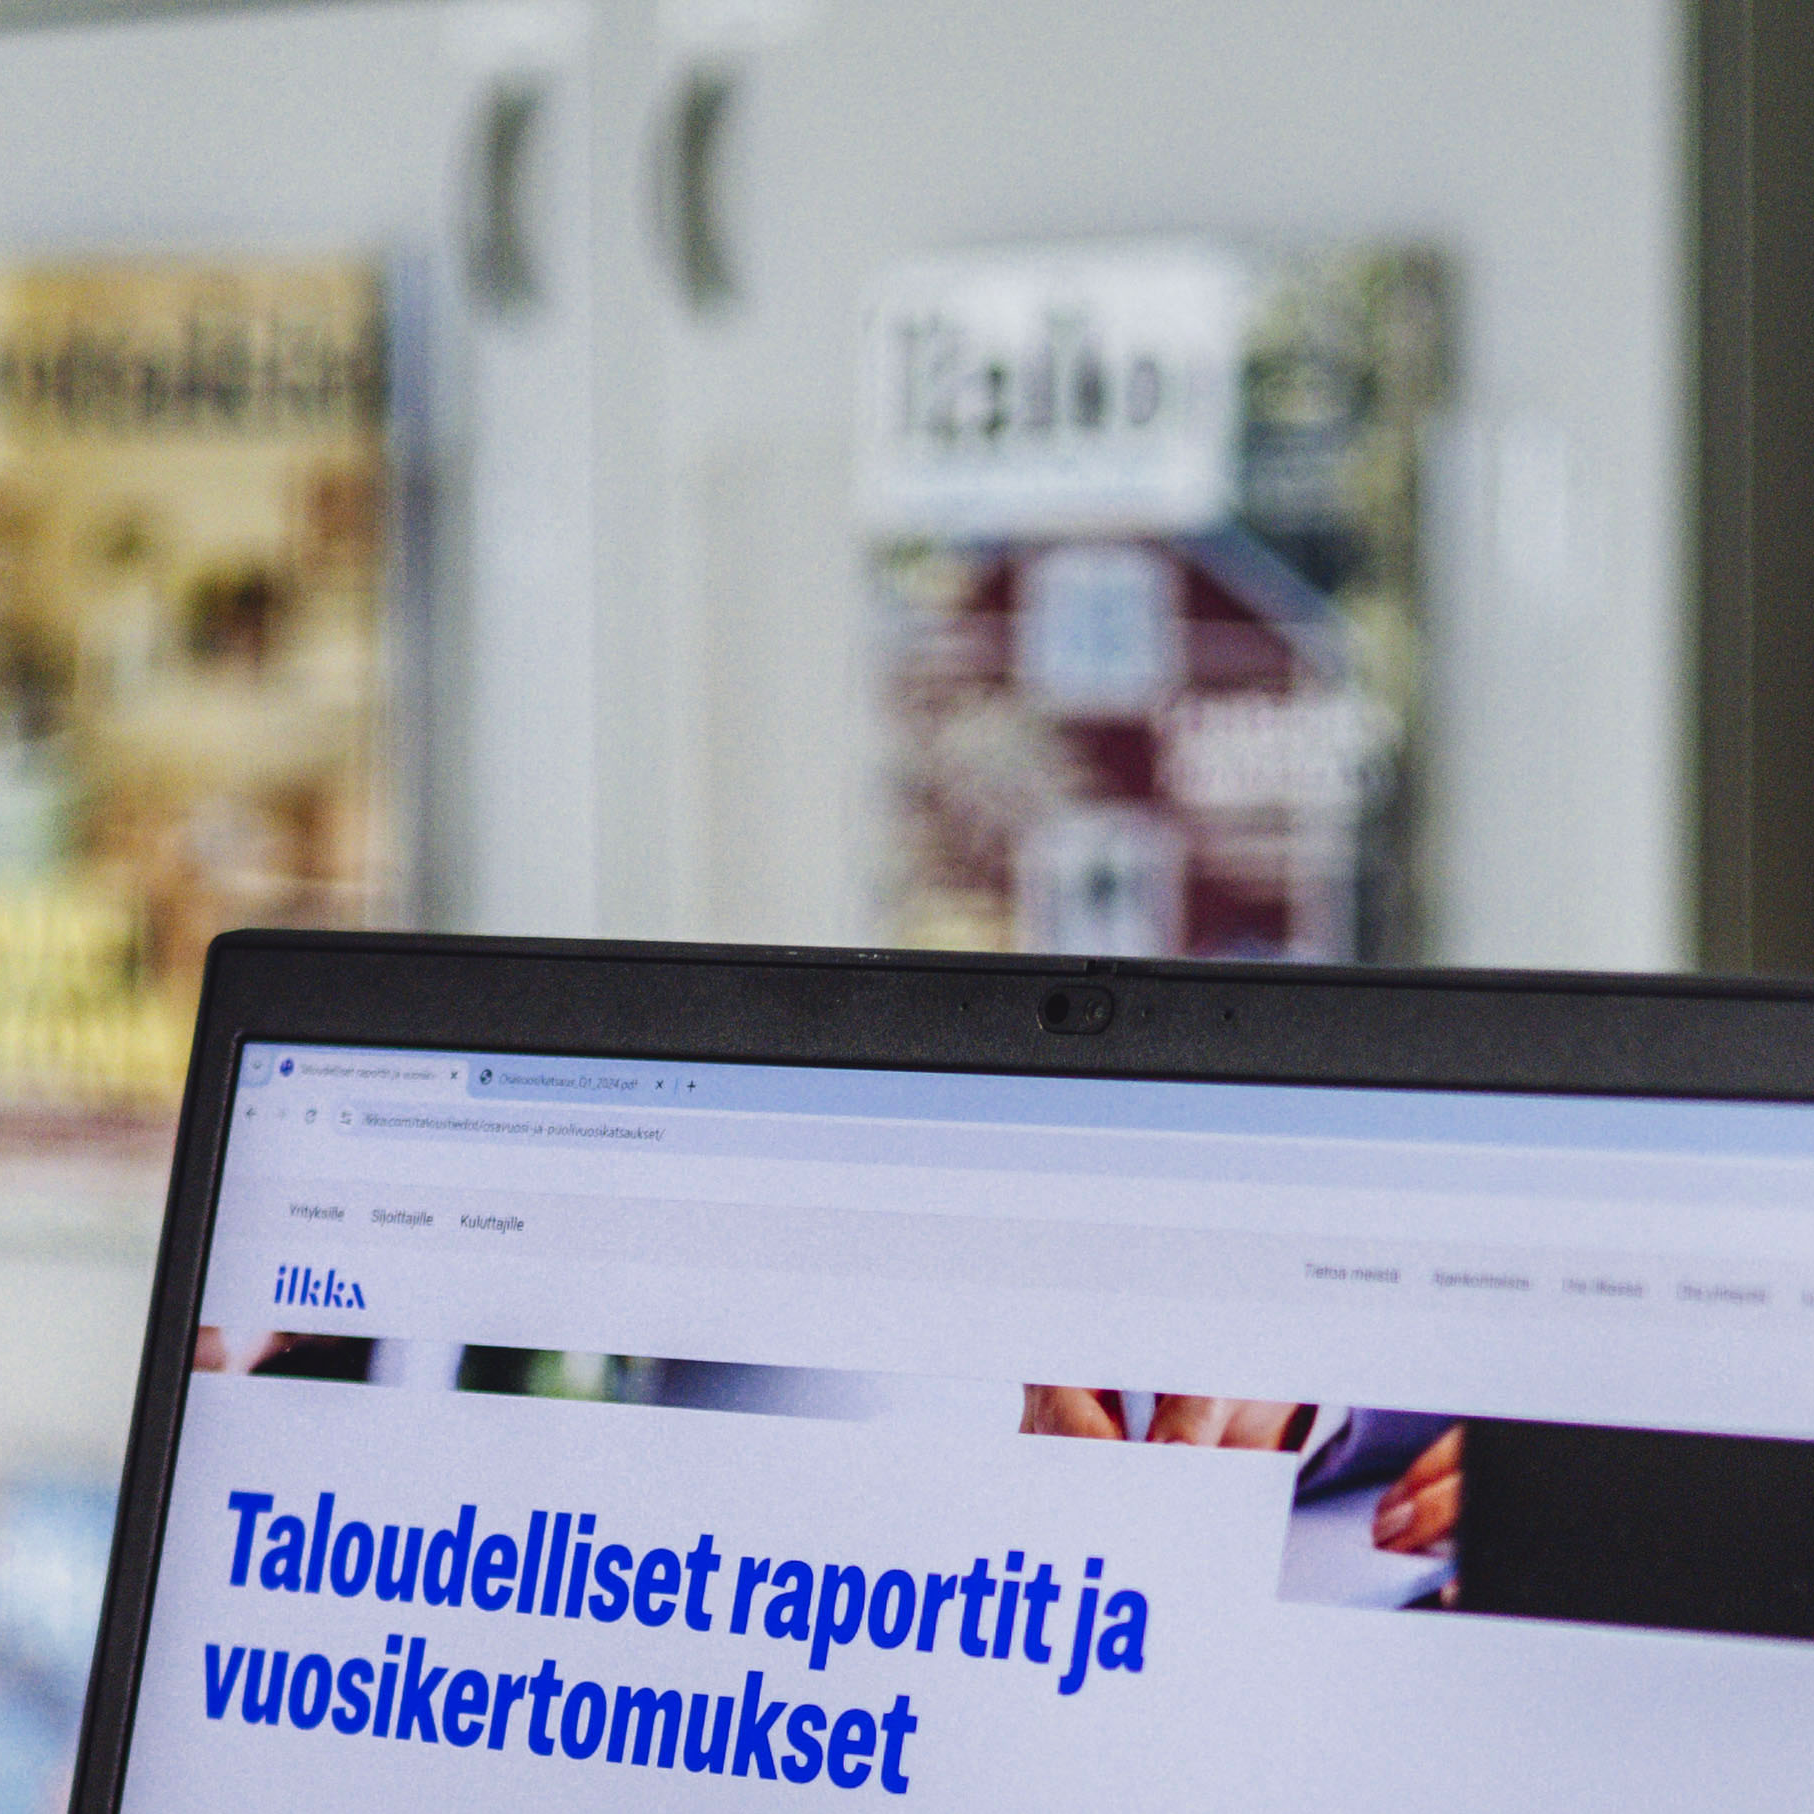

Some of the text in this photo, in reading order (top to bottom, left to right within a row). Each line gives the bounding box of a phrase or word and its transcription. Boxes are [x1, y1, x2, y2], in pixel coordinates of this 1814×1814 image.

[289, 1204, 345, 1223] Yrityksille
[371, 1208, 434, 1230] Sijoittajille
[460, 1213, 525, 1235] Kuluttajille
[274, 1265, 367, 1310] ilkka
[226, 1489, 1152, 1696] Taloudelliset raportit ja
[203, 1634, 921, 1795] vuosikertomukset
